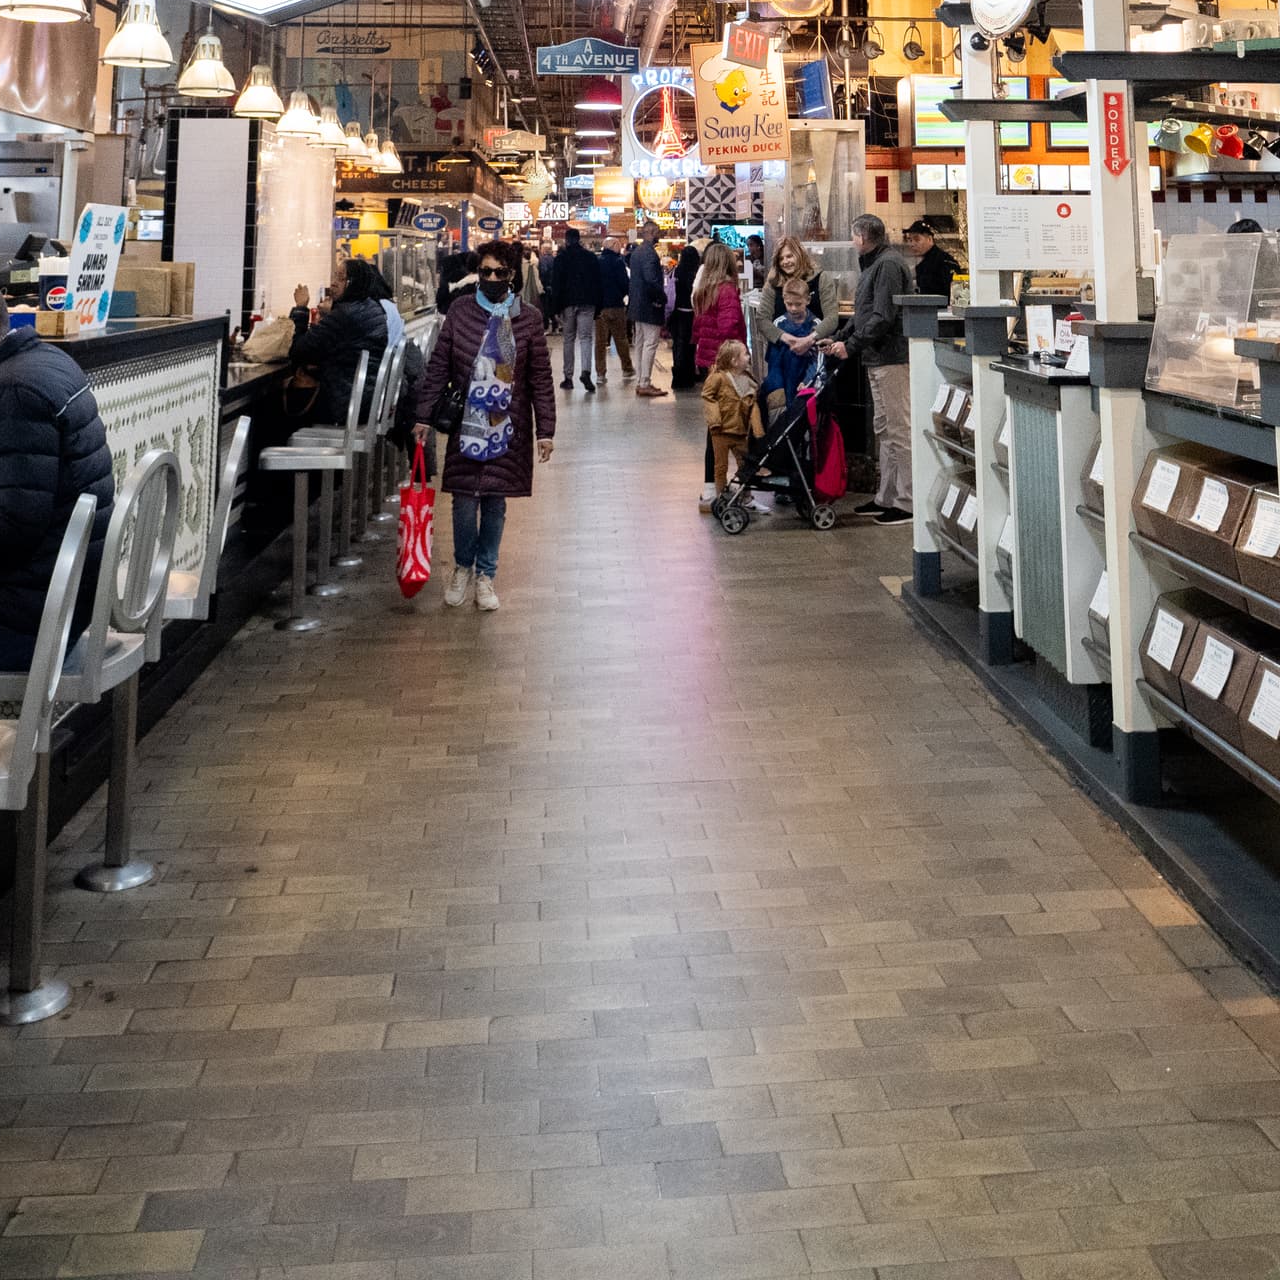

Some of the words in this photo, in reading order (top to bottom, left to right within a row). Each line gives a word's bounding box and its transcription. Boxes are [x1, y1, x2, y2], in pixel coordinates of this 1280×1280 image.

[584, 40, 592, 54] A
[734, 29, 766, 62] EXIT
[542, 55, 551, 69] 4
[555, 54, 568, 64] TH
[570, 54, 635, 66] AVENUE
[704, 116, 750, 142] Sang
[753, 114, 783, 138] Kee
[1108, 110, 1119, 170] ORDER
[708, 144, 748, 156] PEKING
[752, 142, 782, 153] DUCK
[392, 179, 446, 190] CHEESE
[83, 254, 108, 271] JUMBO
[76, 274, 105, 292] SHRIMP
